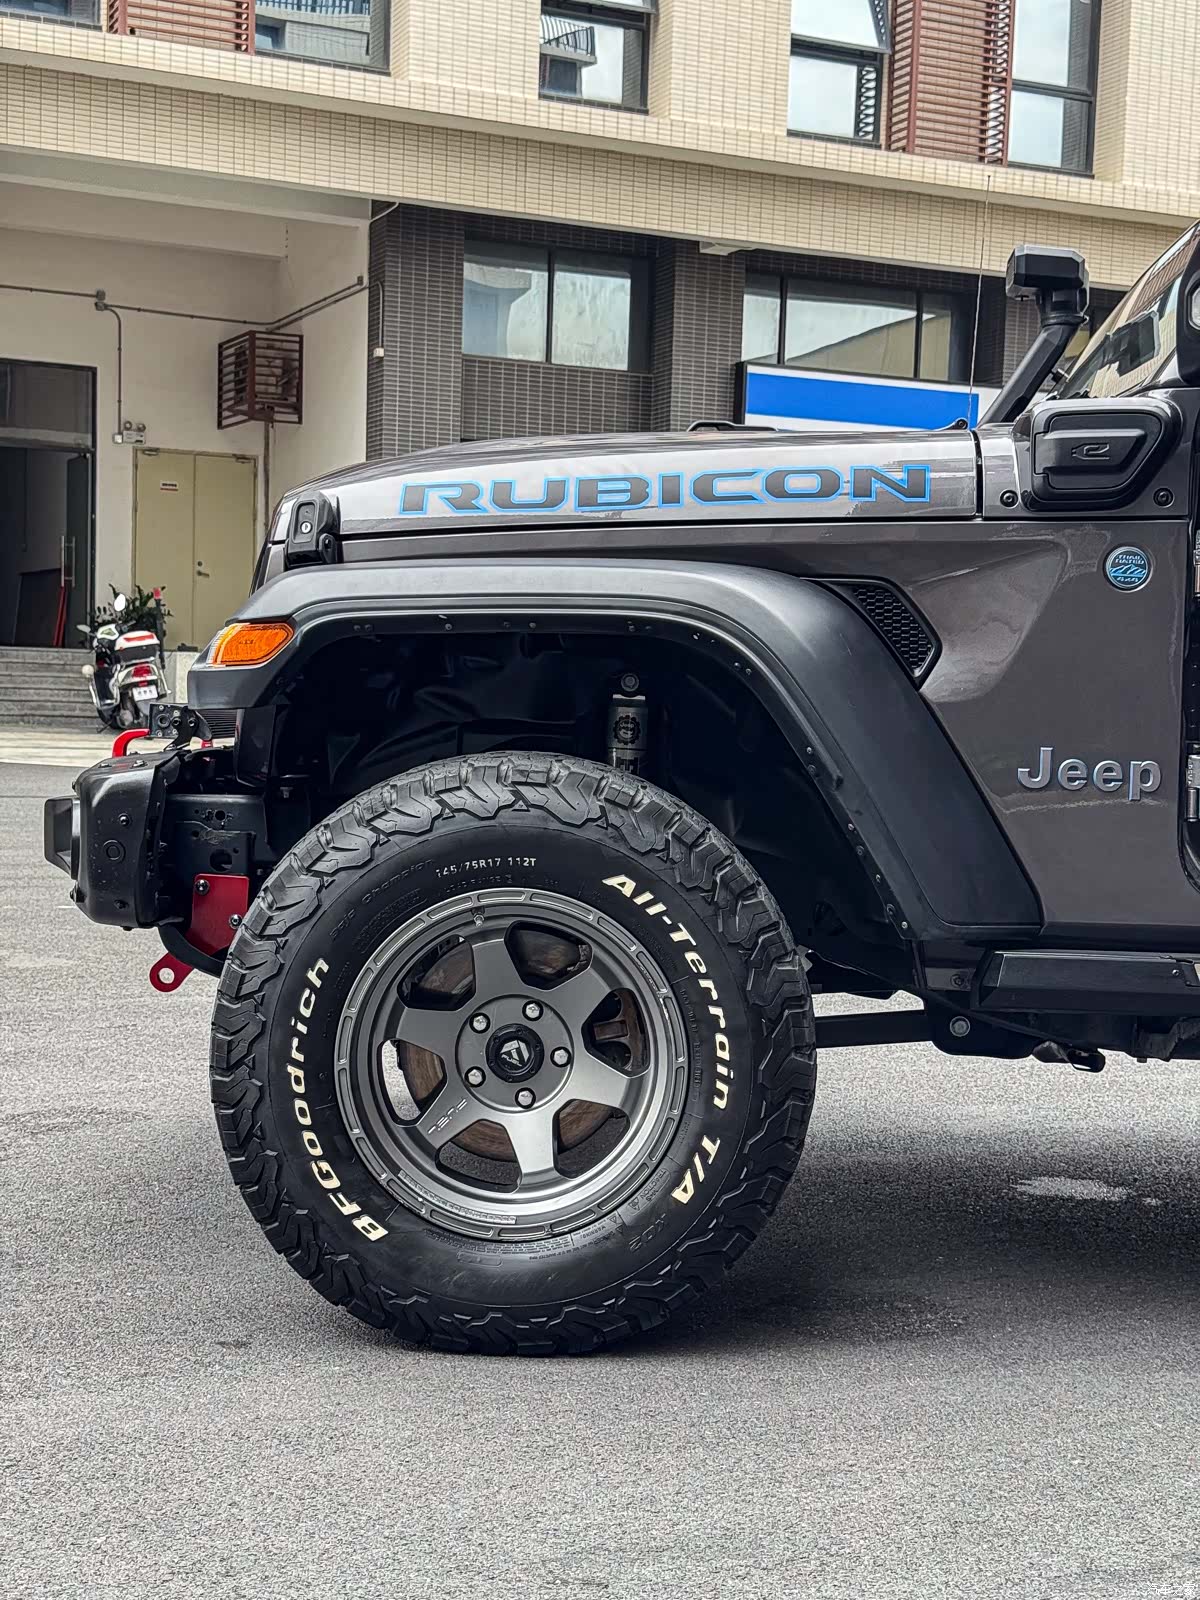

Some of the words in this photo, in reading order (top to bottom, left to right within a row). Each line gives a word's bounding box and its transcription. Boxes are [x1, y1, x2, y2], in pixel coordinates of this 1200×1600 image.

[398, 465, 931, 515] RUBICON
[1018, 747, 1162, 802] Jeep
[508, 857, 537, 867] 112T
[602, 874, 734, 1110] All-Terrain
[671, 1134, 720, 1204] T/A
[286, 957, 389, 1242] BFGoodrich
